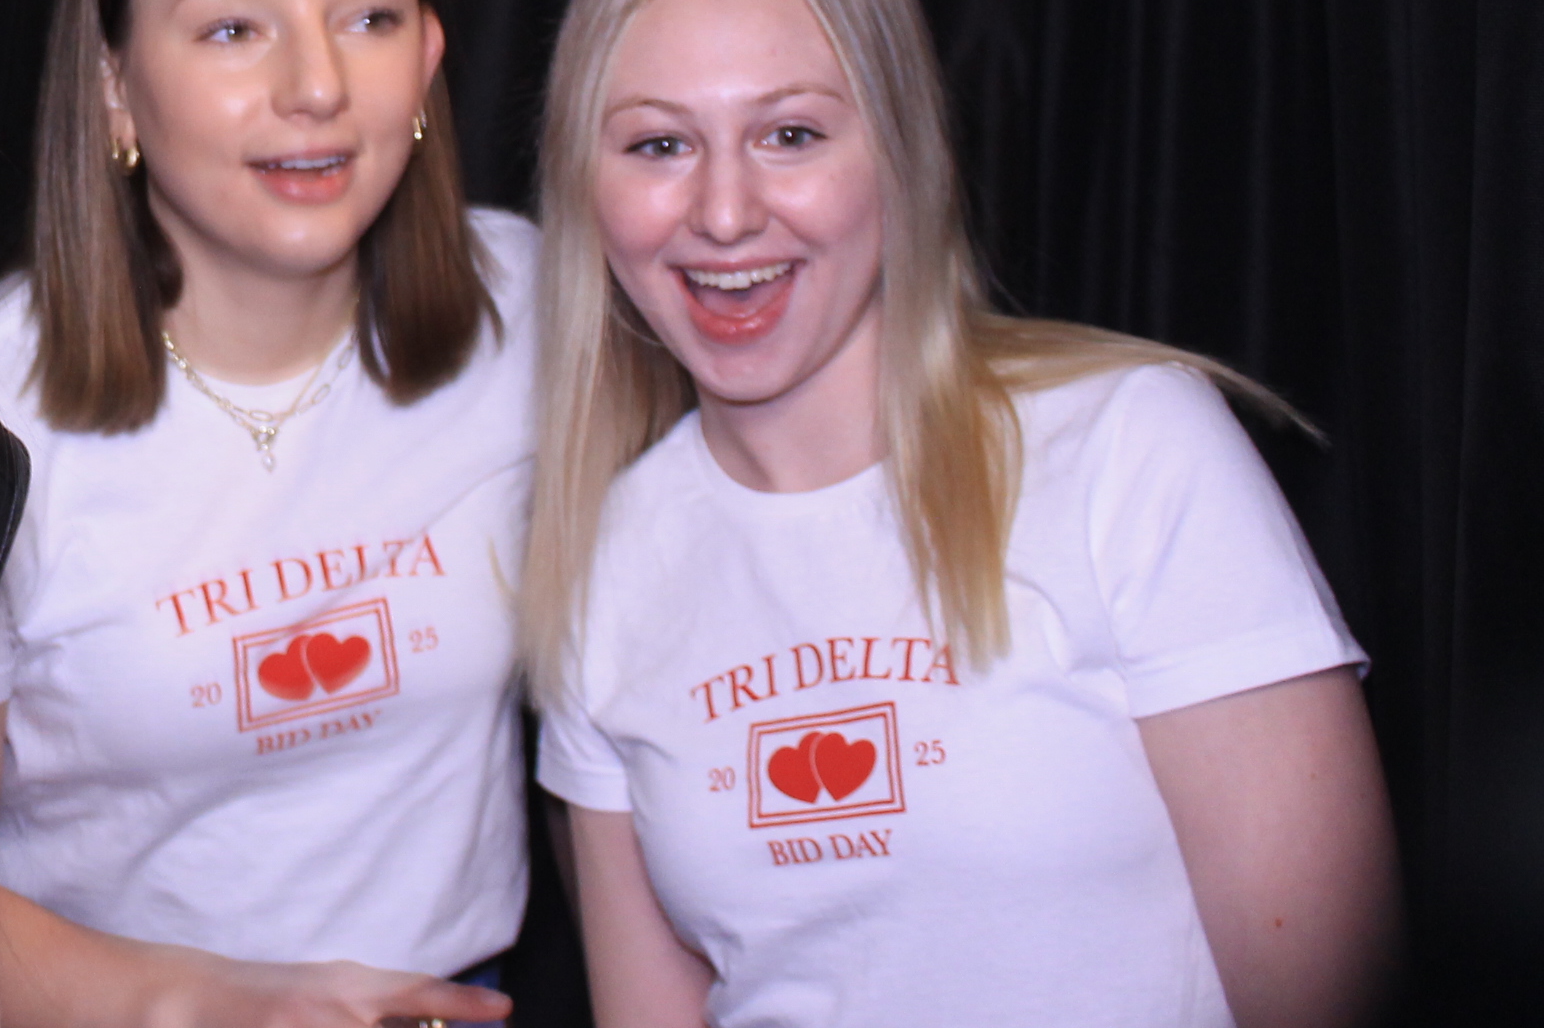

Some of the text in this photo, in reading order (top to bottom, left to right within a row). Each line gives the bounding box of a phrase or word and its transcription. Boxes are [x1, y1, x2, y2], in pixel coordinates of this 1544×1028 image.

[156, 532, 447, 638] TRI DELTA
[190, 626, 440, 709] 20 25
[689, 637, 961, 724] TRI DELTA
[256, 709, 383, 755] BID DAY
[708, 739, 948, 792] 20 25
[767, 828, 894, 867] BID DAY
